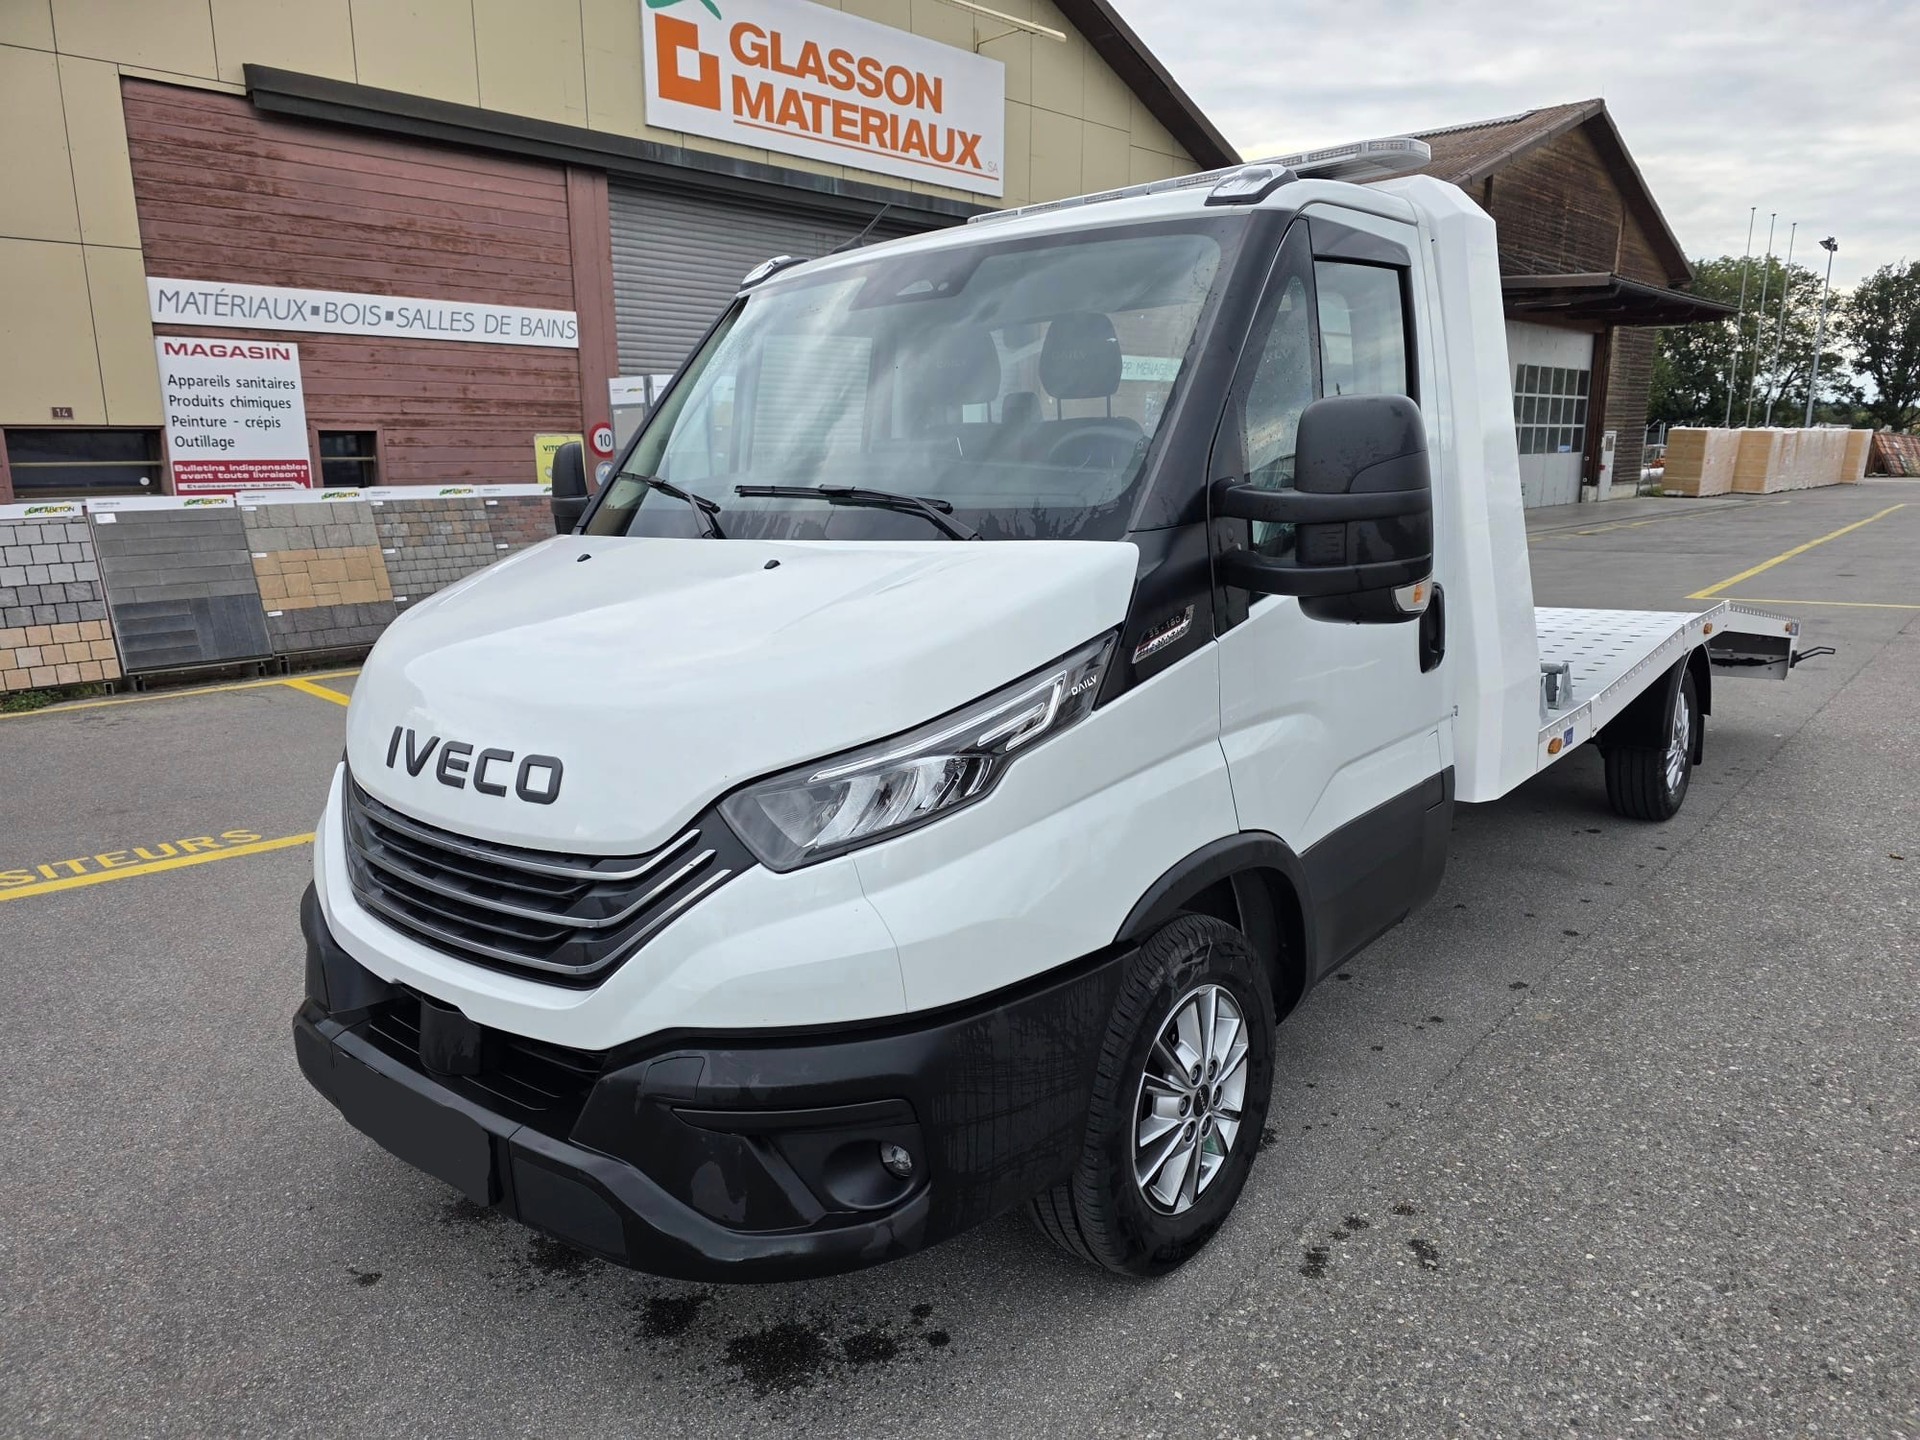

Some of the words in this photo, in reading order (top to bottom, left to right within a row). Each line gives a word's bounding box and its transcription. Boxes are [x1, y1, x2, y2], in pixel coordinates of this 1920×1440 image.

[729, 22, 943, 114] GLASSON
[732, 74, 982, 169] MATERIAUX
[987, 160, 999, 173] SA
[158, 288, 307, 322] MATÉRIAUX
[323, 301, 382, 326] BOIS
[396, 307, 475, 333] SALLES
[484, 313, 512, 335] DE
[520, 316, 577, 340] BAINS
[164, 342, 291, 361] MAGASIN
[168, 374, 231, 390] Appareils
[236, 376, 296, 390] sanitaires
[169, 394, 225, 408] Produits
[230, 396, 292, 412] chimiques
[56, 408, 69, 418] 14
[172, 414, 227, 428] Peinture
[245, 415, 281, 431] crépis
[175, 435, 235, 451] Outillage
[598, 433, 611, 448] 10
[174, 464, 226, 472] Bulletins
[229, 463, 308, 473] indispensables
[218, 471, 250, 479] toute
[252, 470, 298, 478] livraison
[1071, 675, 1098, 696] DAILY
[386, 726, 564, 805] IVECO
[0, 829, 262, 887] SITEURS
